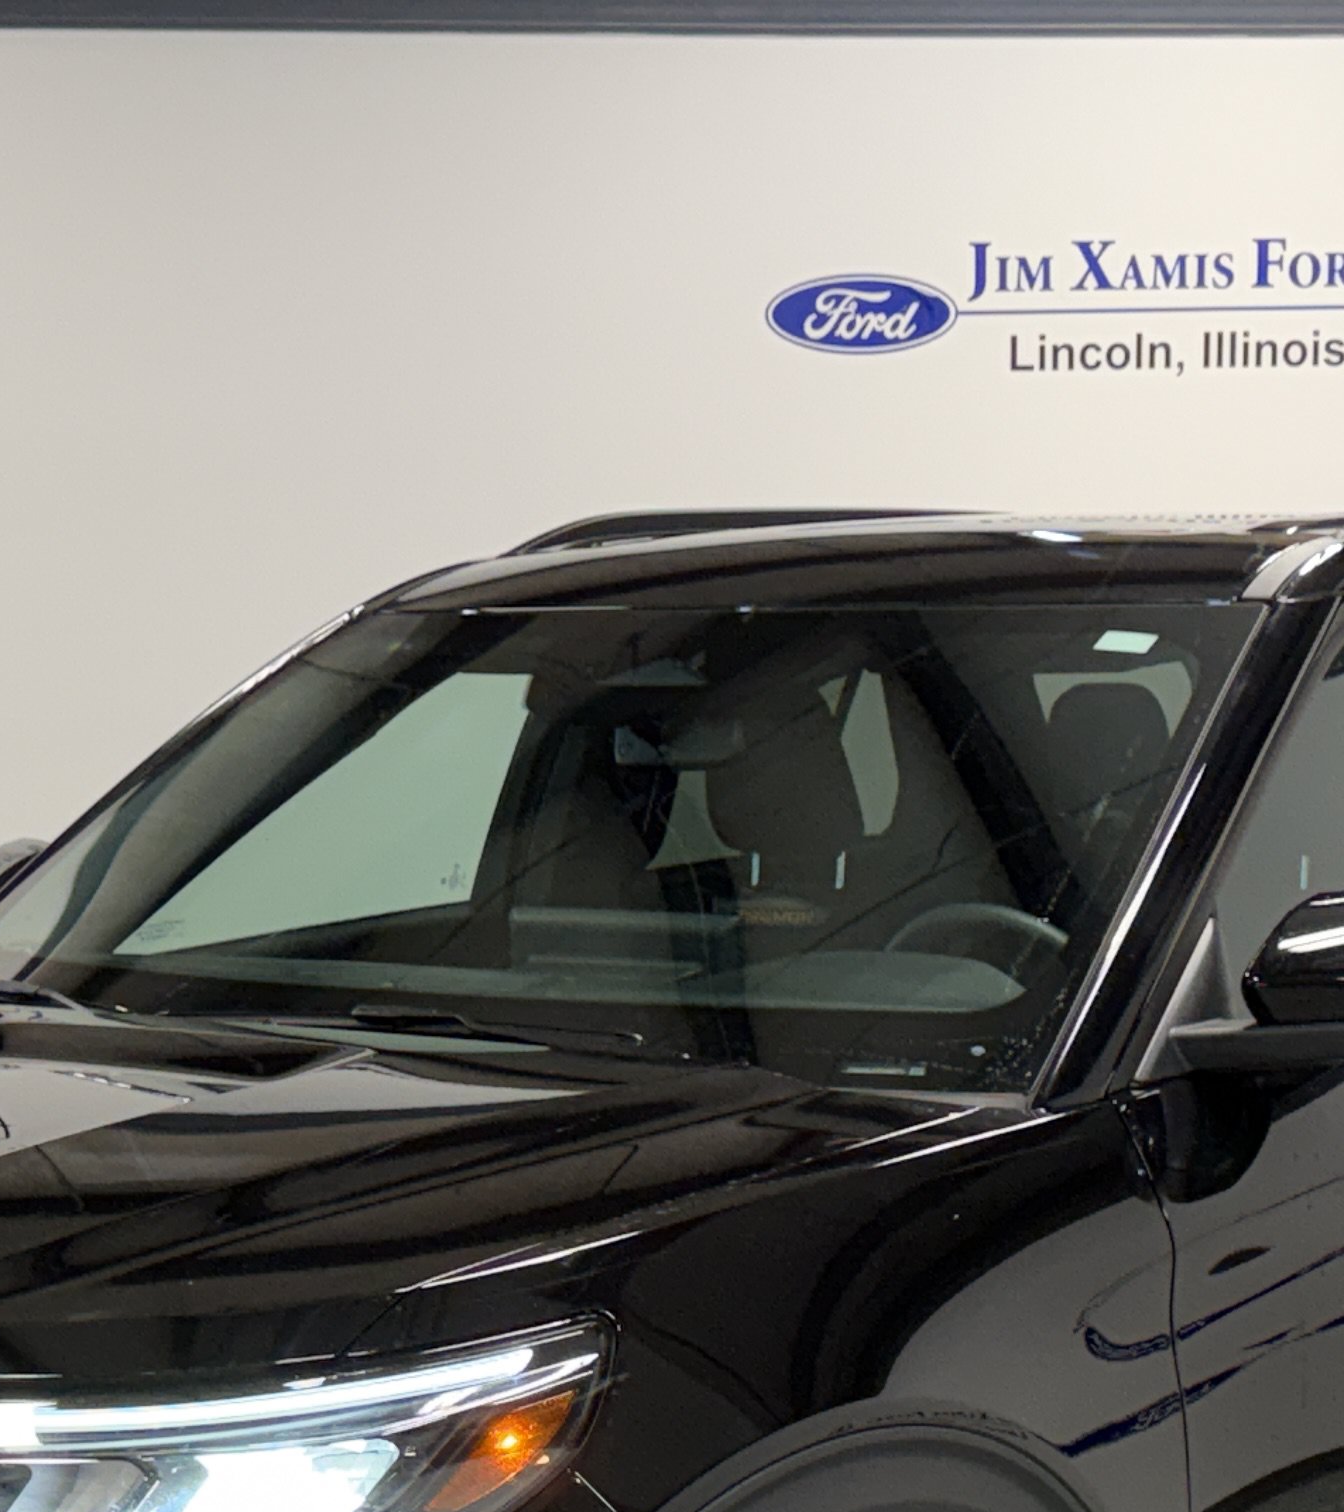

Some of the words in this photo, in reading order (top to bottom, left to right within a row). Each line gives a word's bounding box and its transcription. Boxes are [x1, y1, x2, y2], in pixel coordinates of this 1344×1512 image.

[967, 241, 1053, 302] JIM
[1069, 240, 1235, 292] XAMIS
[803, 288, 920, 340] Ford
[1009, 333, 1185, 377] Lincoln,
